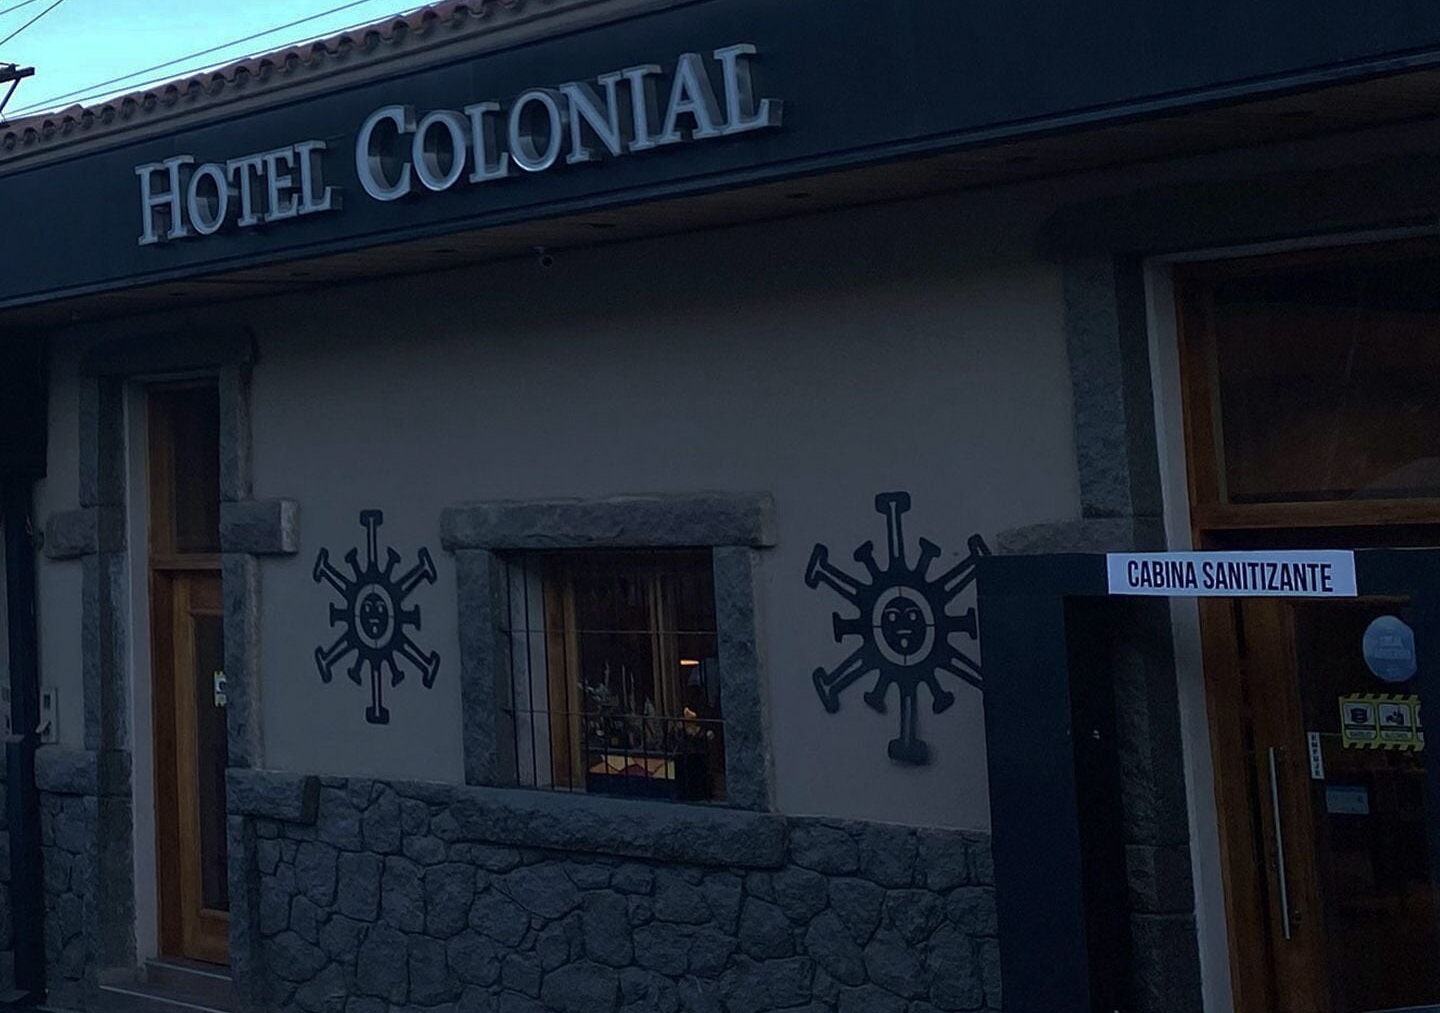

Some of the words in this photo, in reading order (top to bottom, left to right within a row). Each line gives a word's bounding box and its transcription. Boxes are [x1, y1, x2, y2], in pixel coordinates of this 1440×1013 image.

[135, 139, 342, 246] HOTEL
[355, 43, 783, 202] COLONIAL
[1127, 560, 1198, 589] CABINA
[1203, 561, 1334, 593] SANITIZANTE
